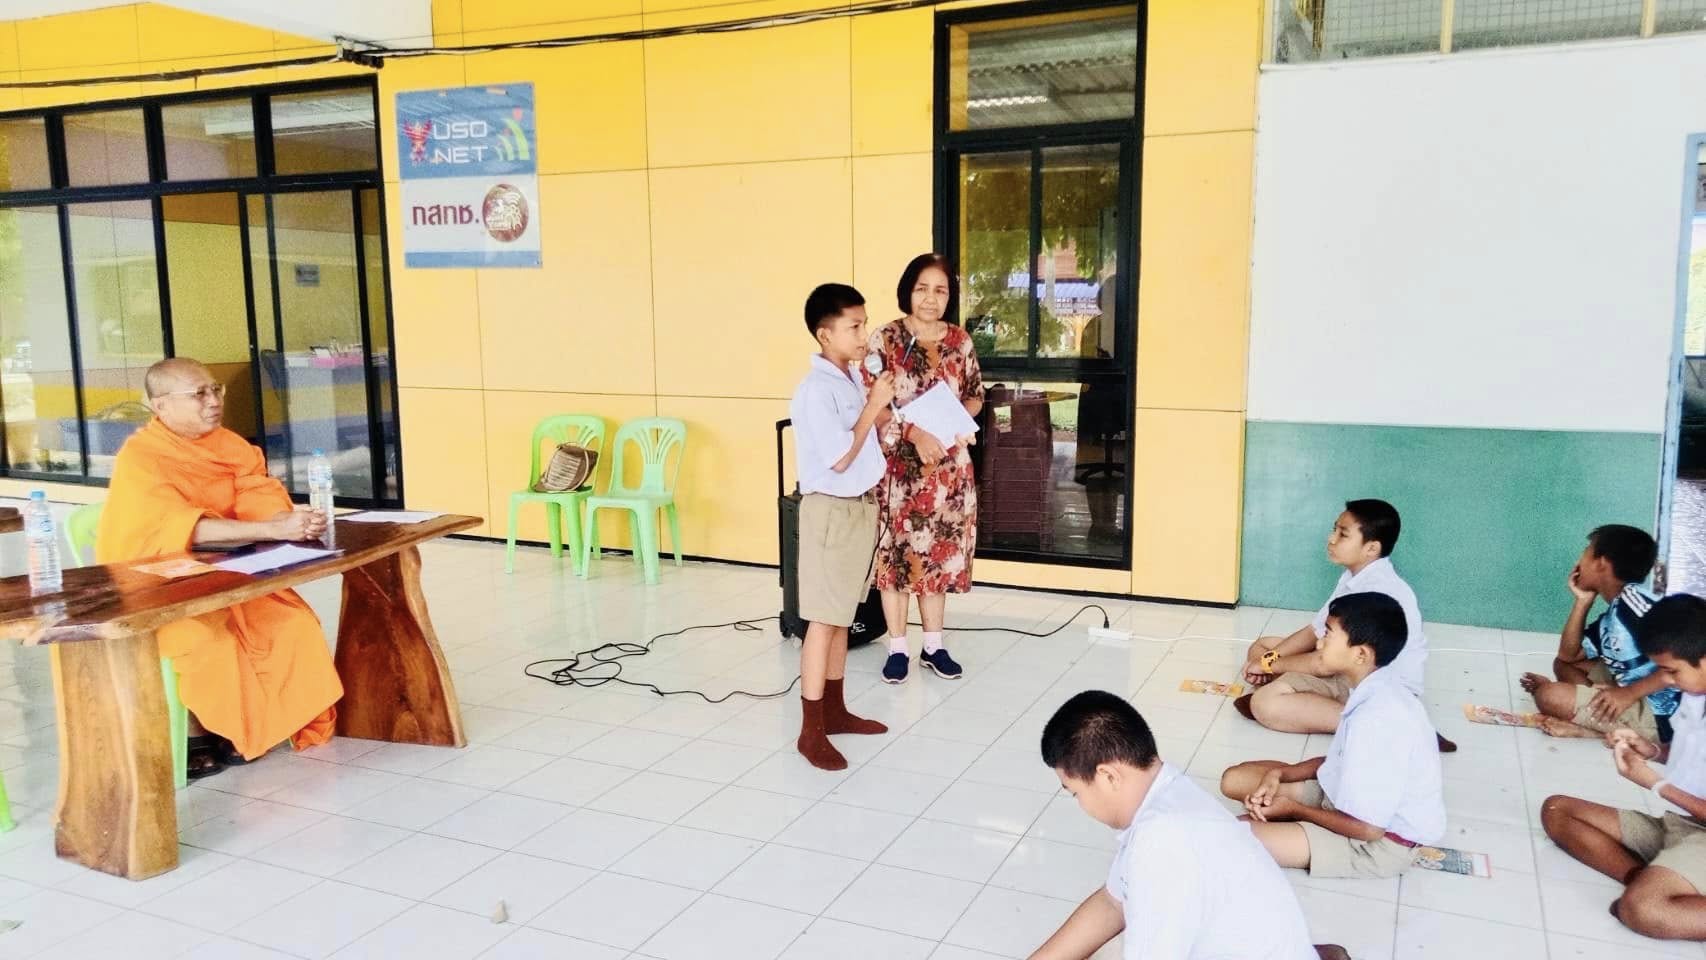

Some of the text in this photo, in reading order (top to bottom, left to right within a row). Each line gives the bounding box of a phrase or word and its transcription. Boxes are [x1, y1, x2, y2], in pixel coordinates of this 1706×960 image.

[433, 120, 488, 140] USO
[434, 145, 489, 164] NET
[412, 204, 479, 225] กสทช.
